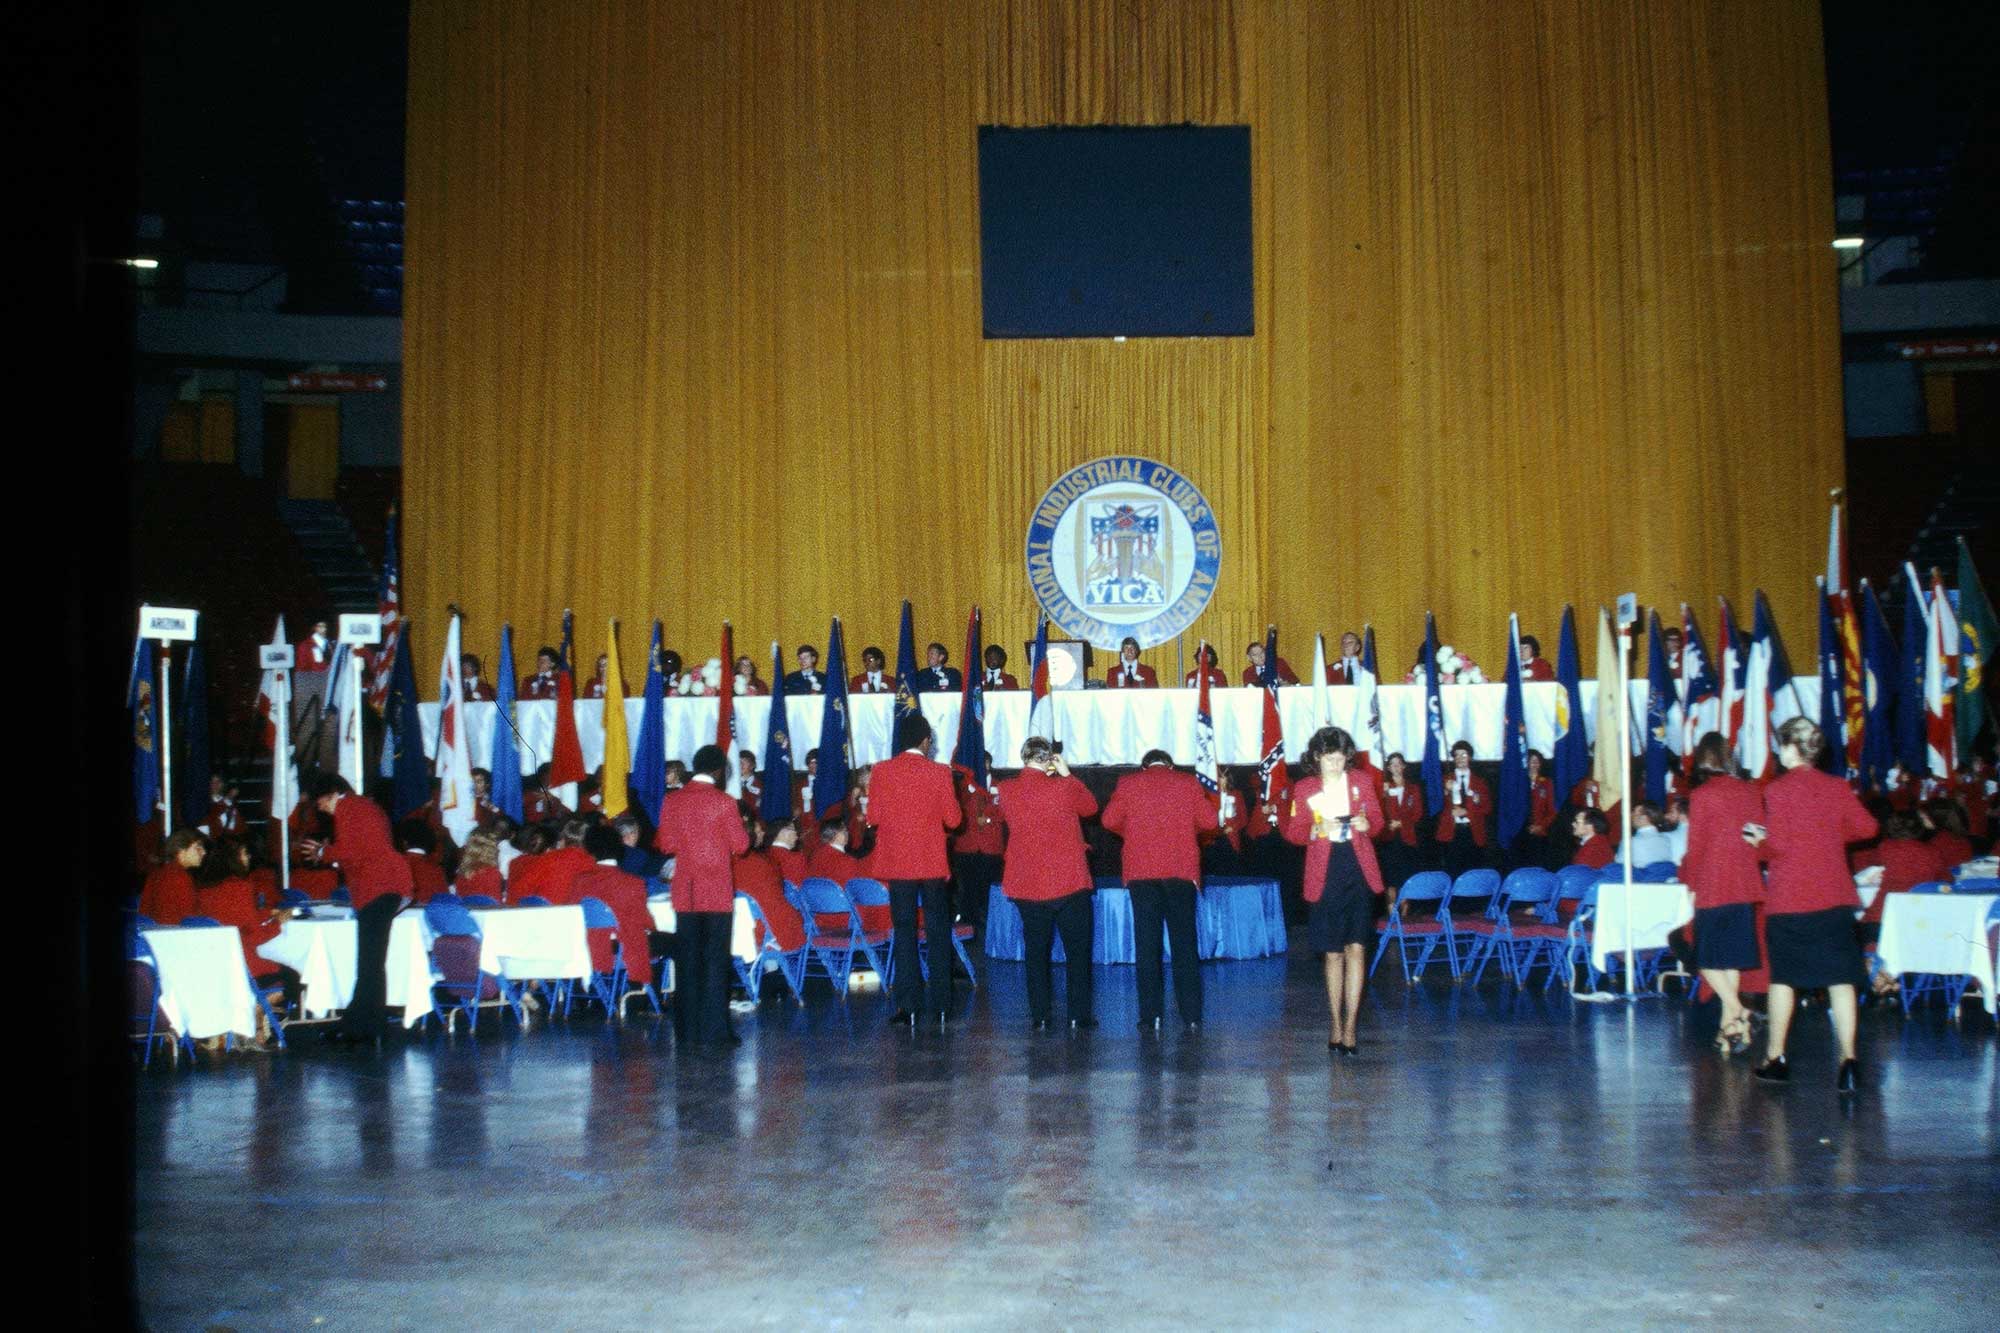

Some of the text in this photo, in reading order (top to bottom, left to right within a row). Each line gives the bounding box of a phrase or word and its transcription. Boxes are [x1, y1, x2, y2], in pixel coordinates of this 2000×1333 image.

[1030, 459, 1218, 648] VOCATIONAL INDUSTRIAL CLUBS OF AMERICA
[1088, 585, 1163, 603] VICA
